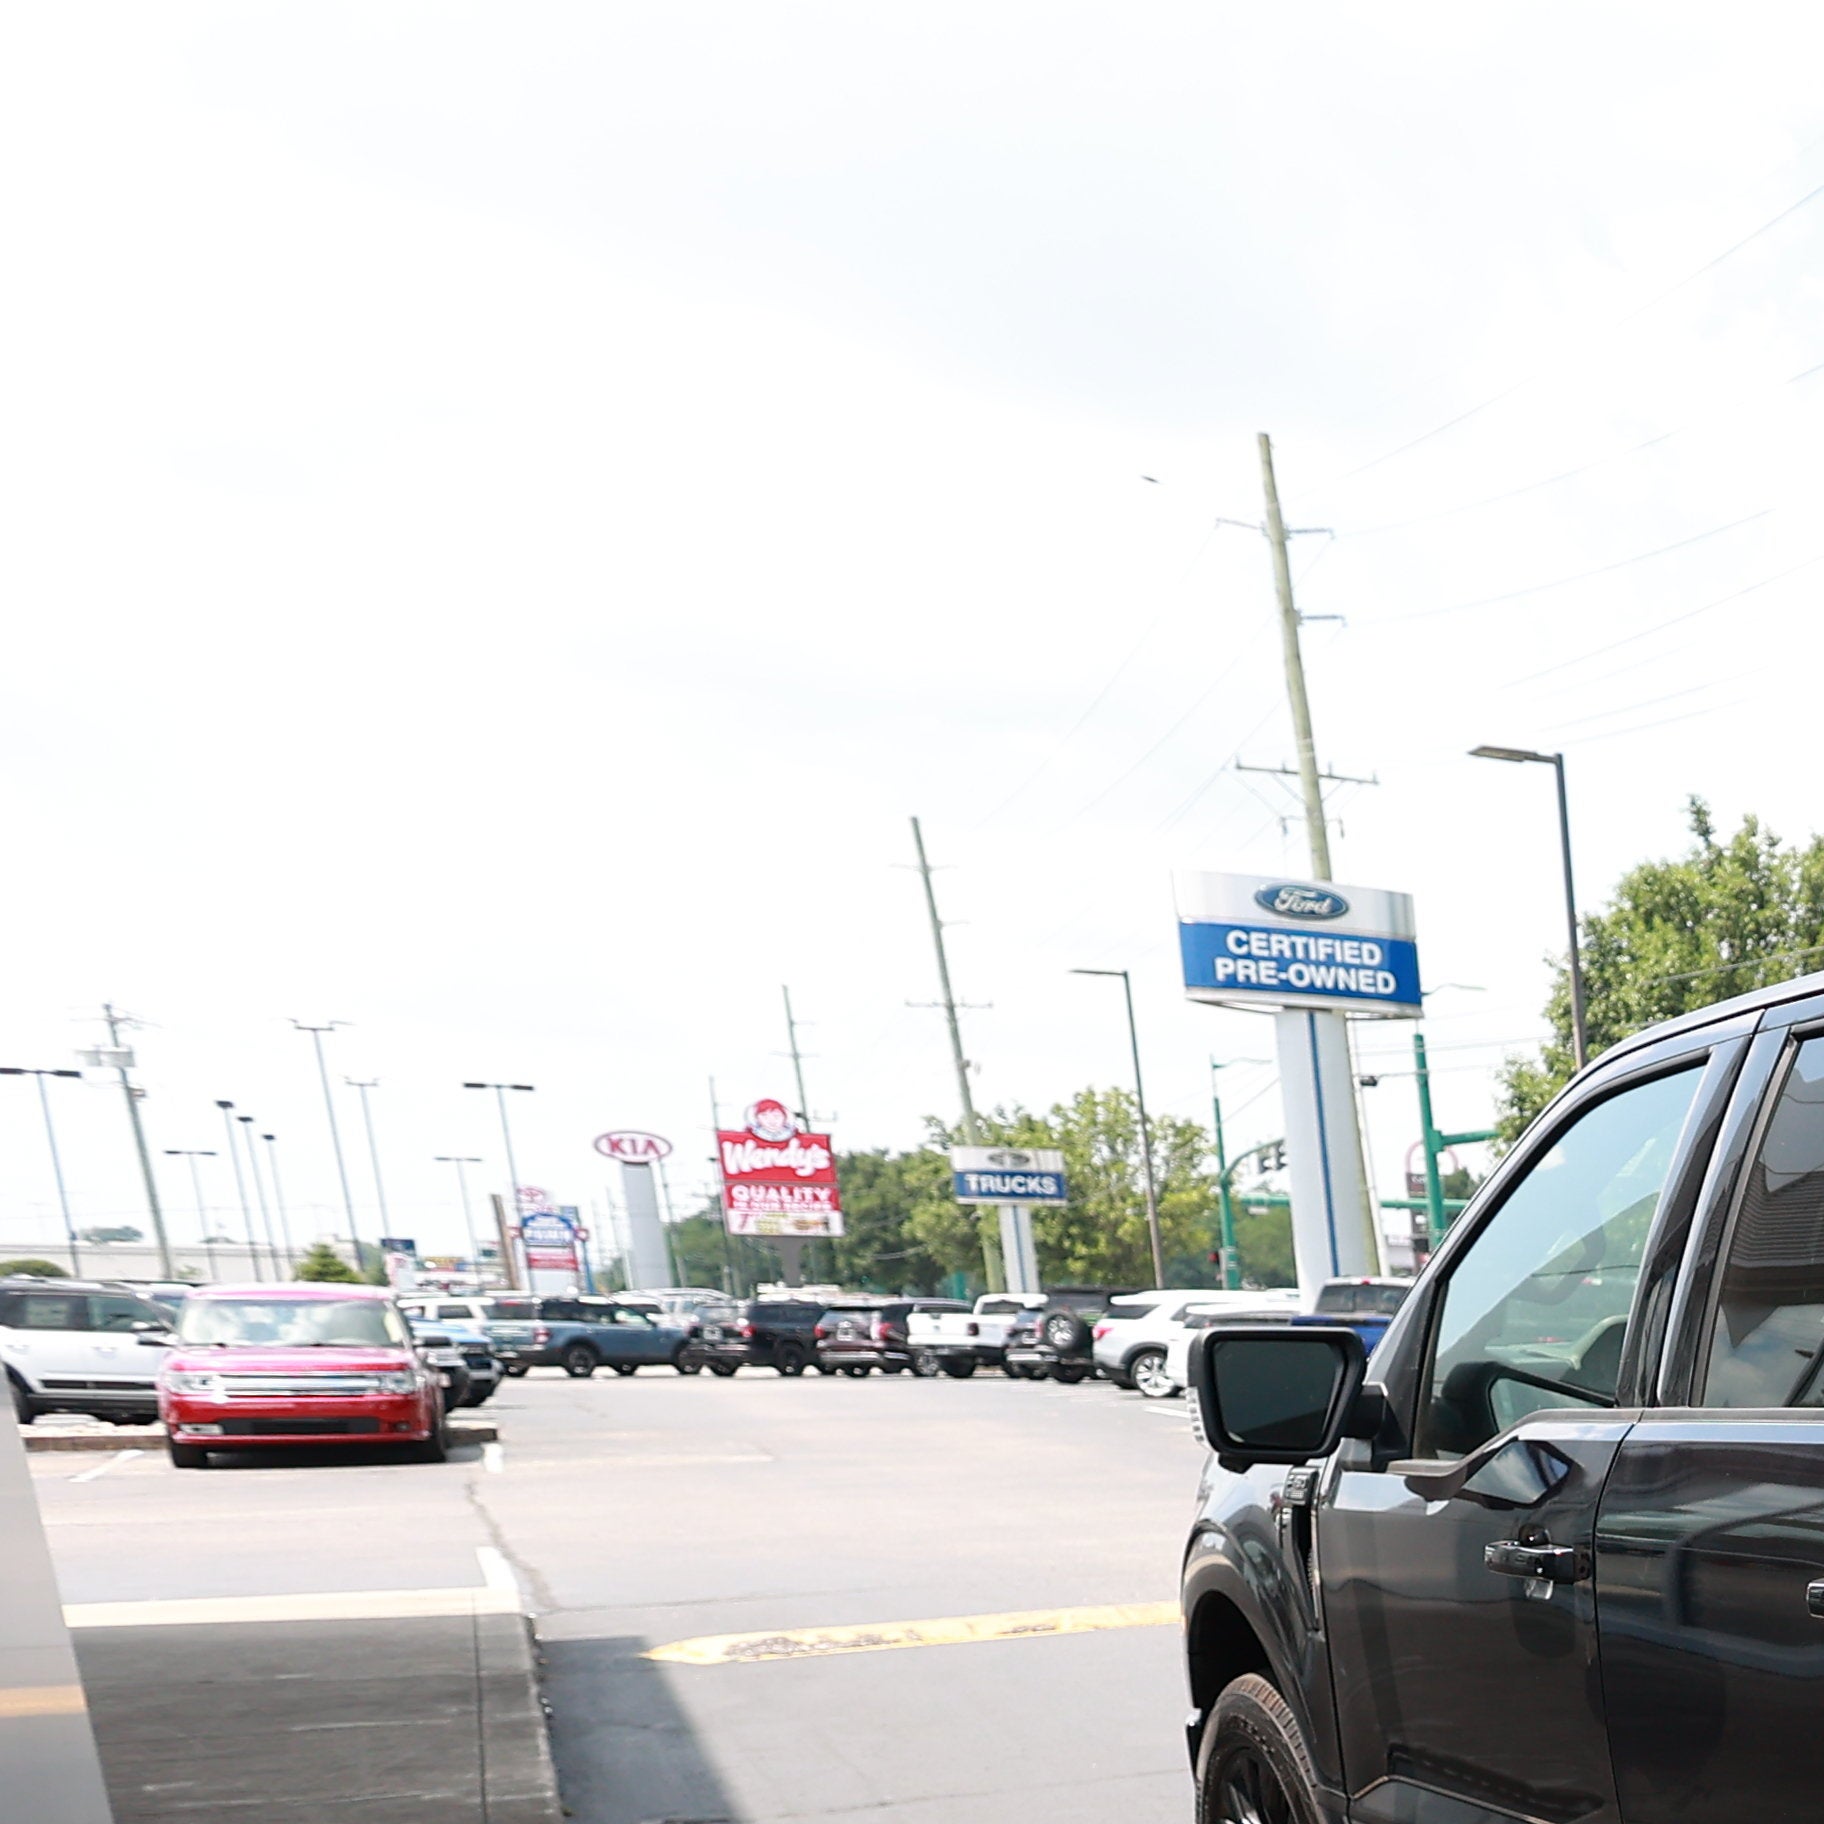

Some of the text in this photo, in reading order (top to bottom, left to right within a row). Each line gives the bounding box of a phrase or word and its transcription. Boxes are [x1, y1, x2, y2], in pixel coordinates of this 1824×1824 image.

[1226, 929, 1382, 966] CERTIFIED
[1214, 957, 1397, 994] PRE-OWNED
[605, 1138, 661, 1156] KIA
[721, 1139, 831, 1177] Wendy's
[731, 1184, 833, 1202] QUALITY
[964, 1174, 1058, 1194] TRUCKS
